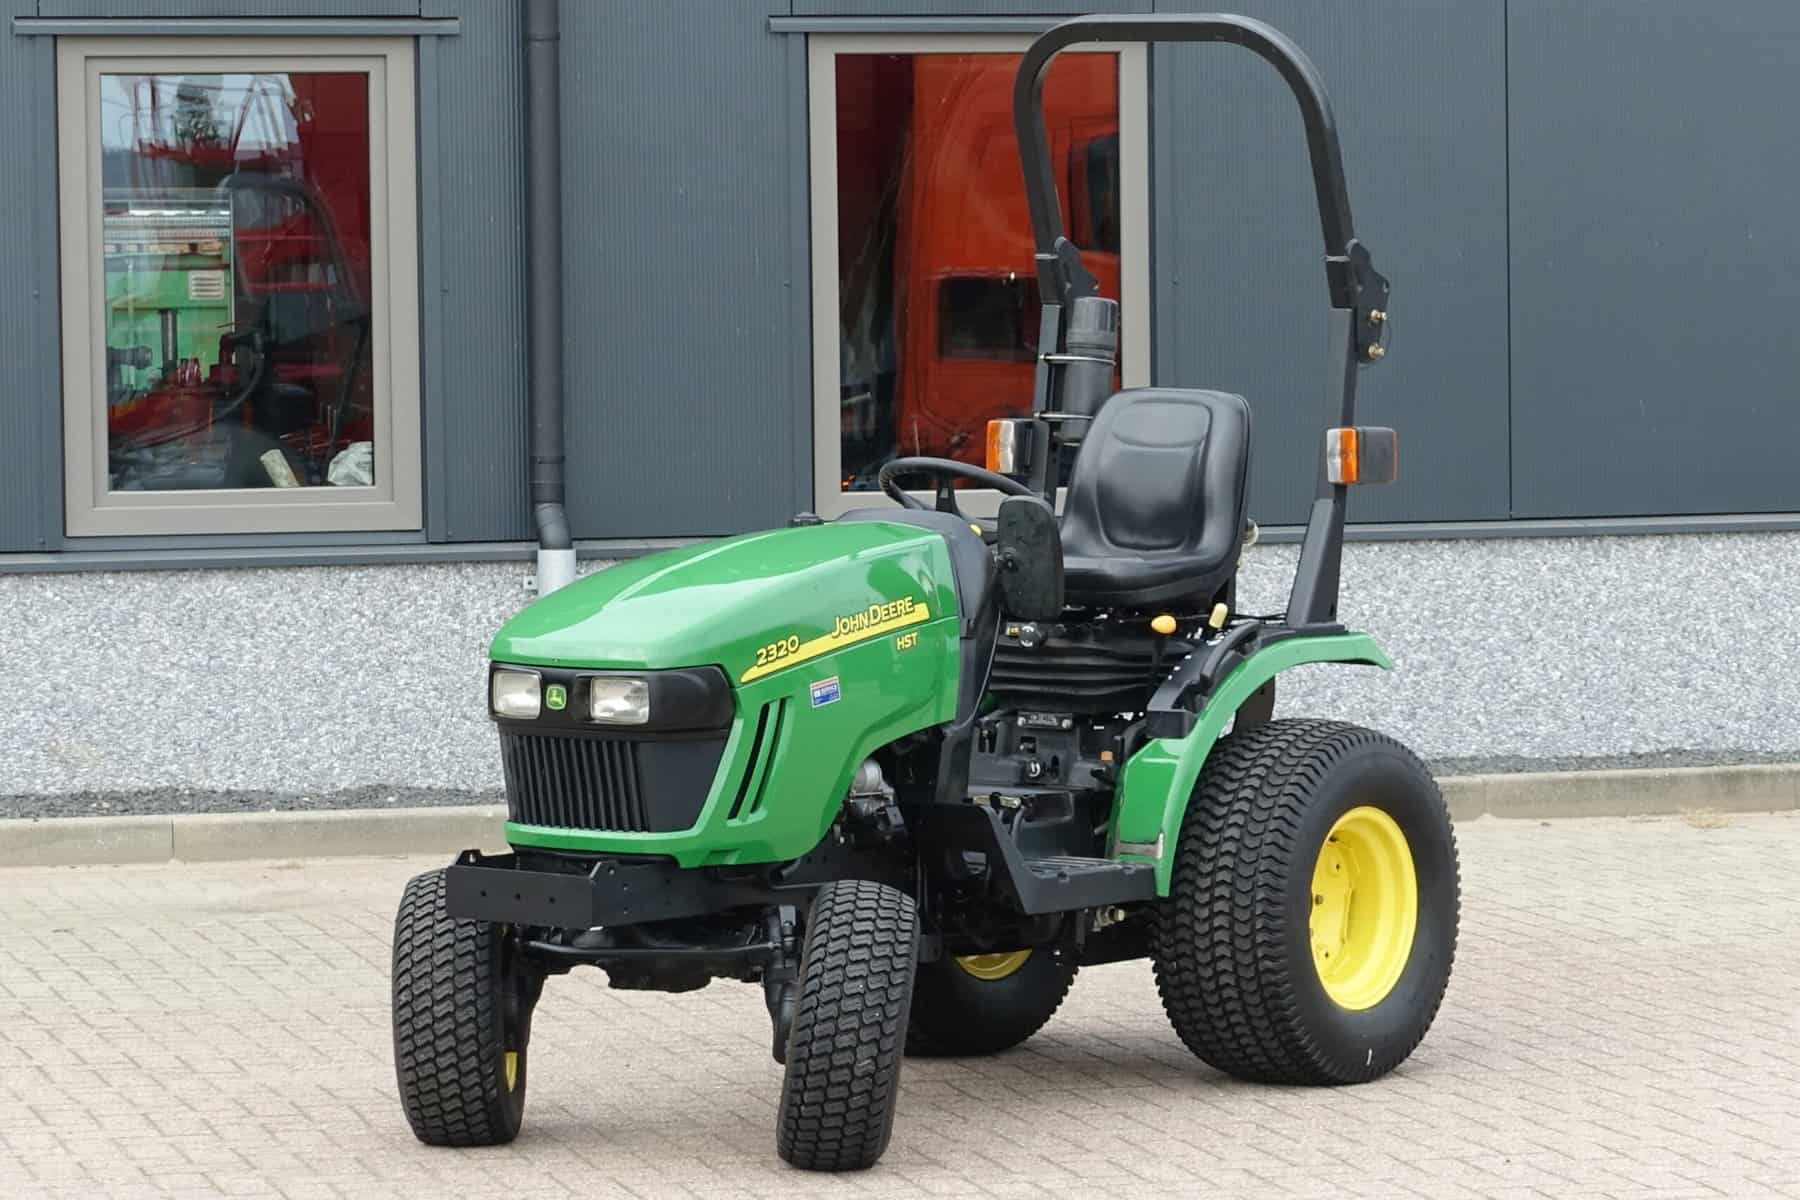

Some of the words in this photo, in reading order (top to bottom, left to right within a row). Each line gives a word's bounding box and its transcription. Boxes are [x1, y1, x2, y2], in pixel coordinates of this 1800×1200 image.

[832, 612, 869, 638] JOHN
[869, 596, 914, 627] DEERE
[756, 635, 799, 666] 2320
[896, 632, 918, 650] HST
